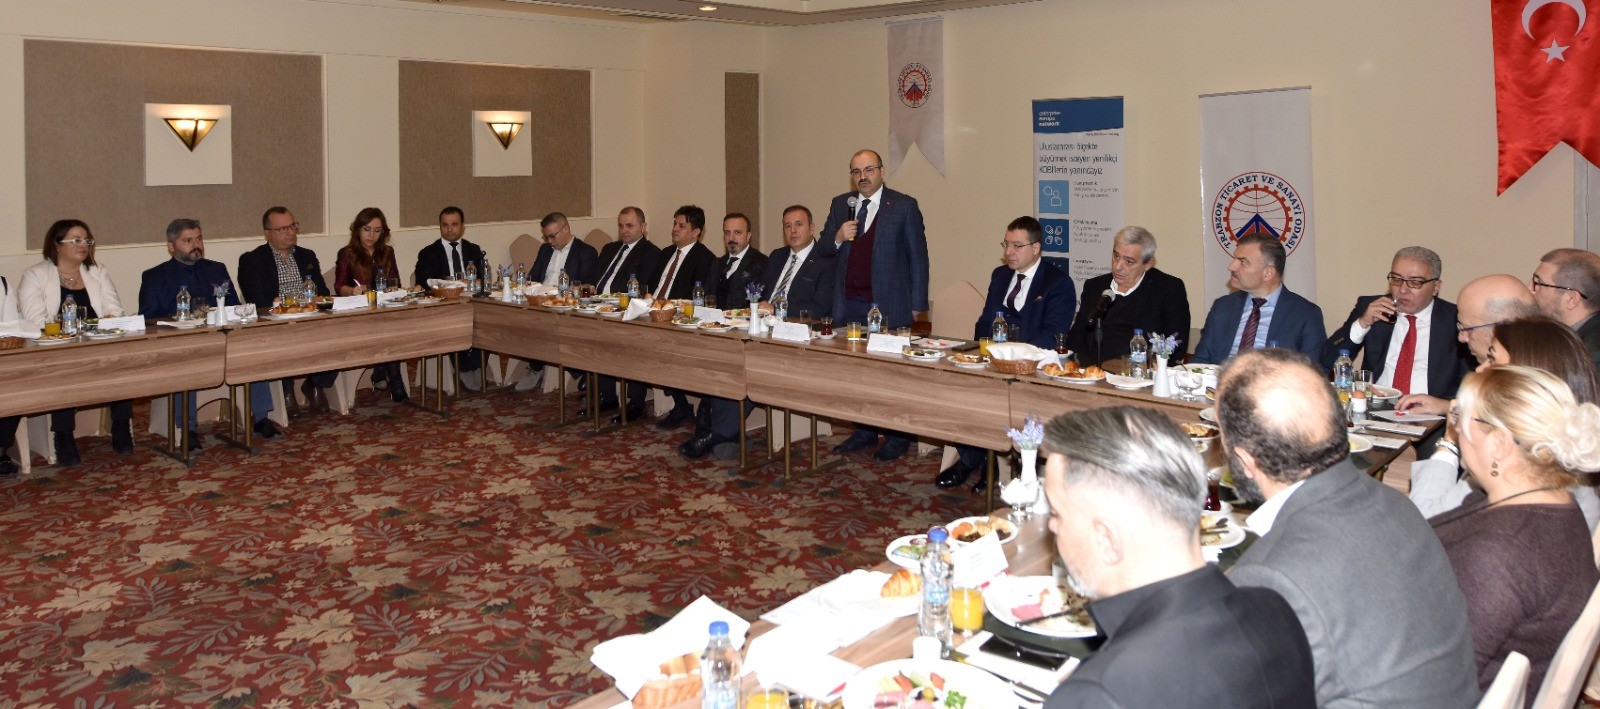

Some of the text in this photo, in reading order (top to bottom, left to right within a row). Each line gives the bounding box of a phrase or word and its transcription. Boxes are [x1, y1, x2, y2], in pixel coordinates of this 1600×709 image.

[1220, 174, 1258, 201] TİCARET
[1261, 175, 1275, 185] VE
[1214, 202, 1232, 249] TRABZON
[1284, 218, 1303, 249] ODASI
